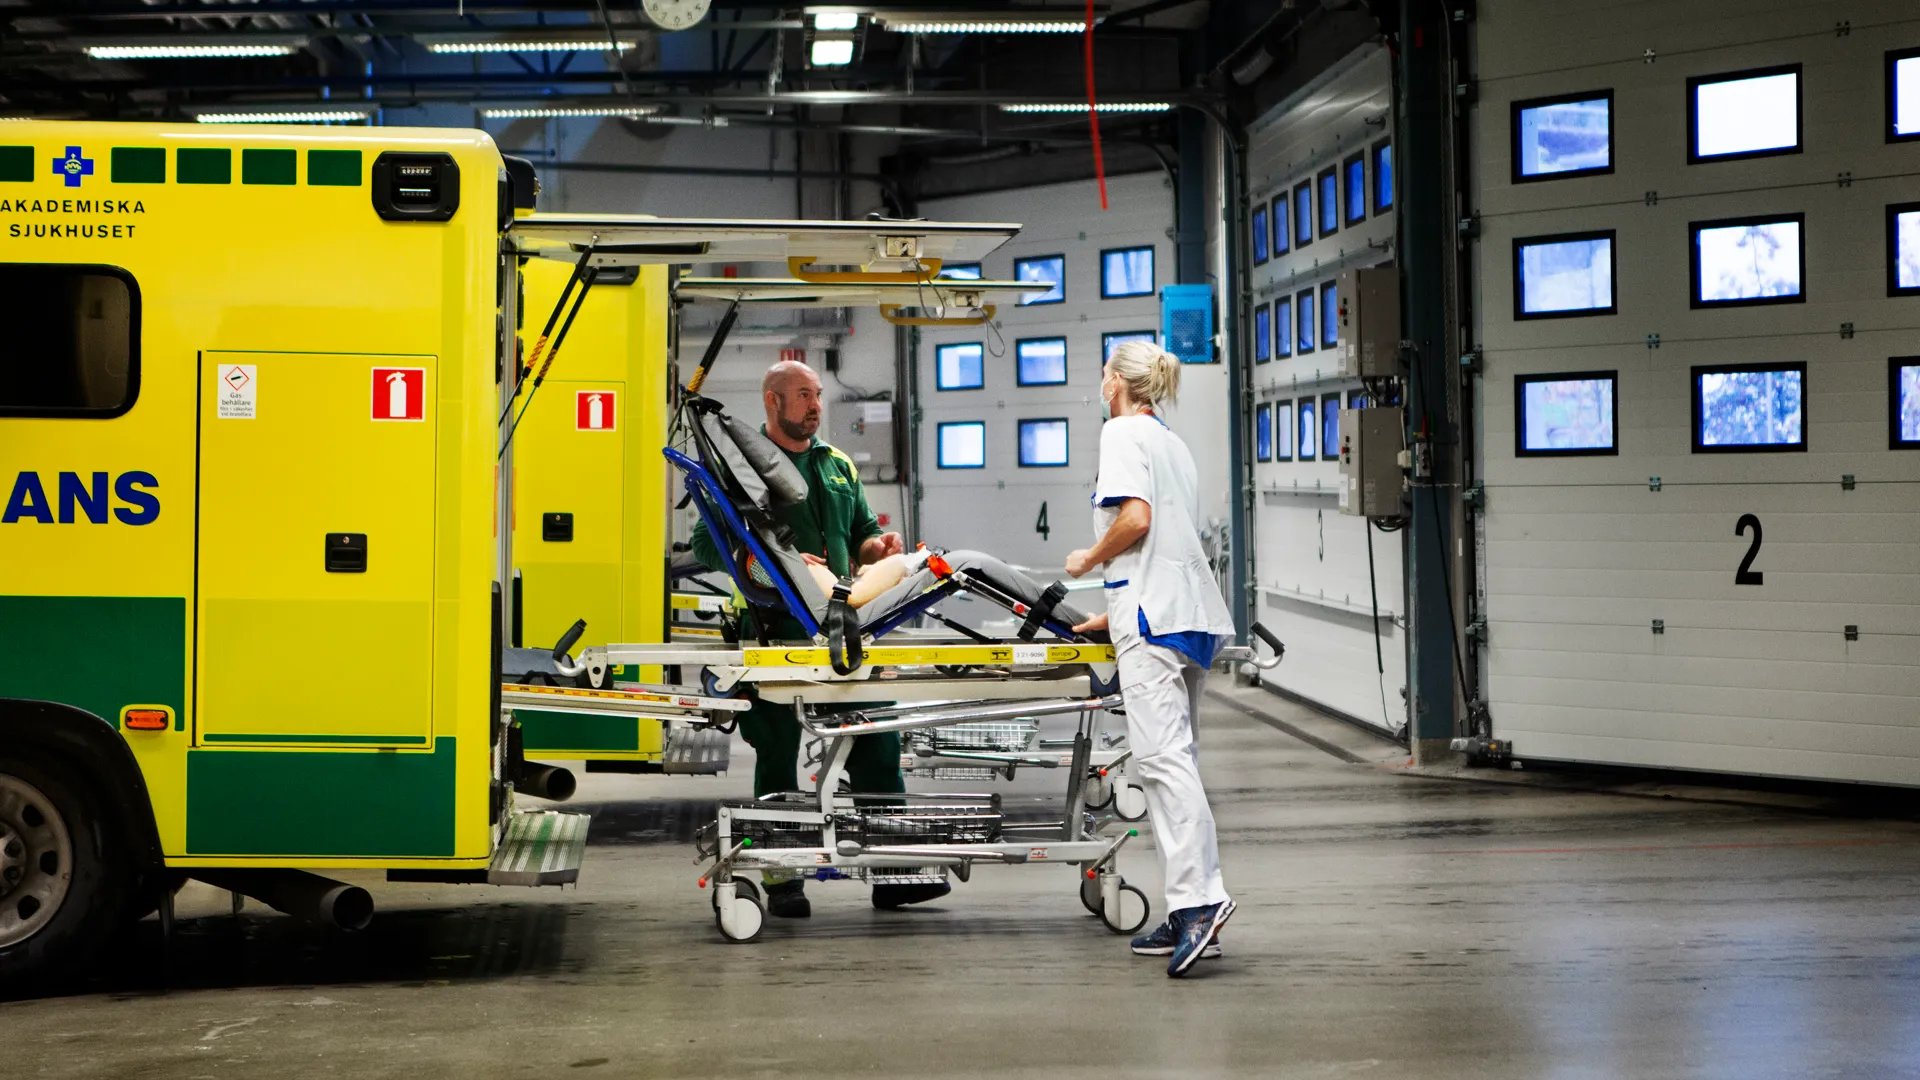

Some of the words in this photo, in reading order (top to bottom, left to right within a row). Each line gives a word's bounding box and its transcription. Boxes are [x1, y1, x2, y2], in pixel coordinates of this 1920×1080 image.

[0, 199, 145, 214] AKADEMISKA
[9, 223, 136, 238] SJUKHUSET
[1, 470, 161, 526] ANS
[1036, 500, 1050, 541] 4
[1735, 513, 1763, 585] 2
